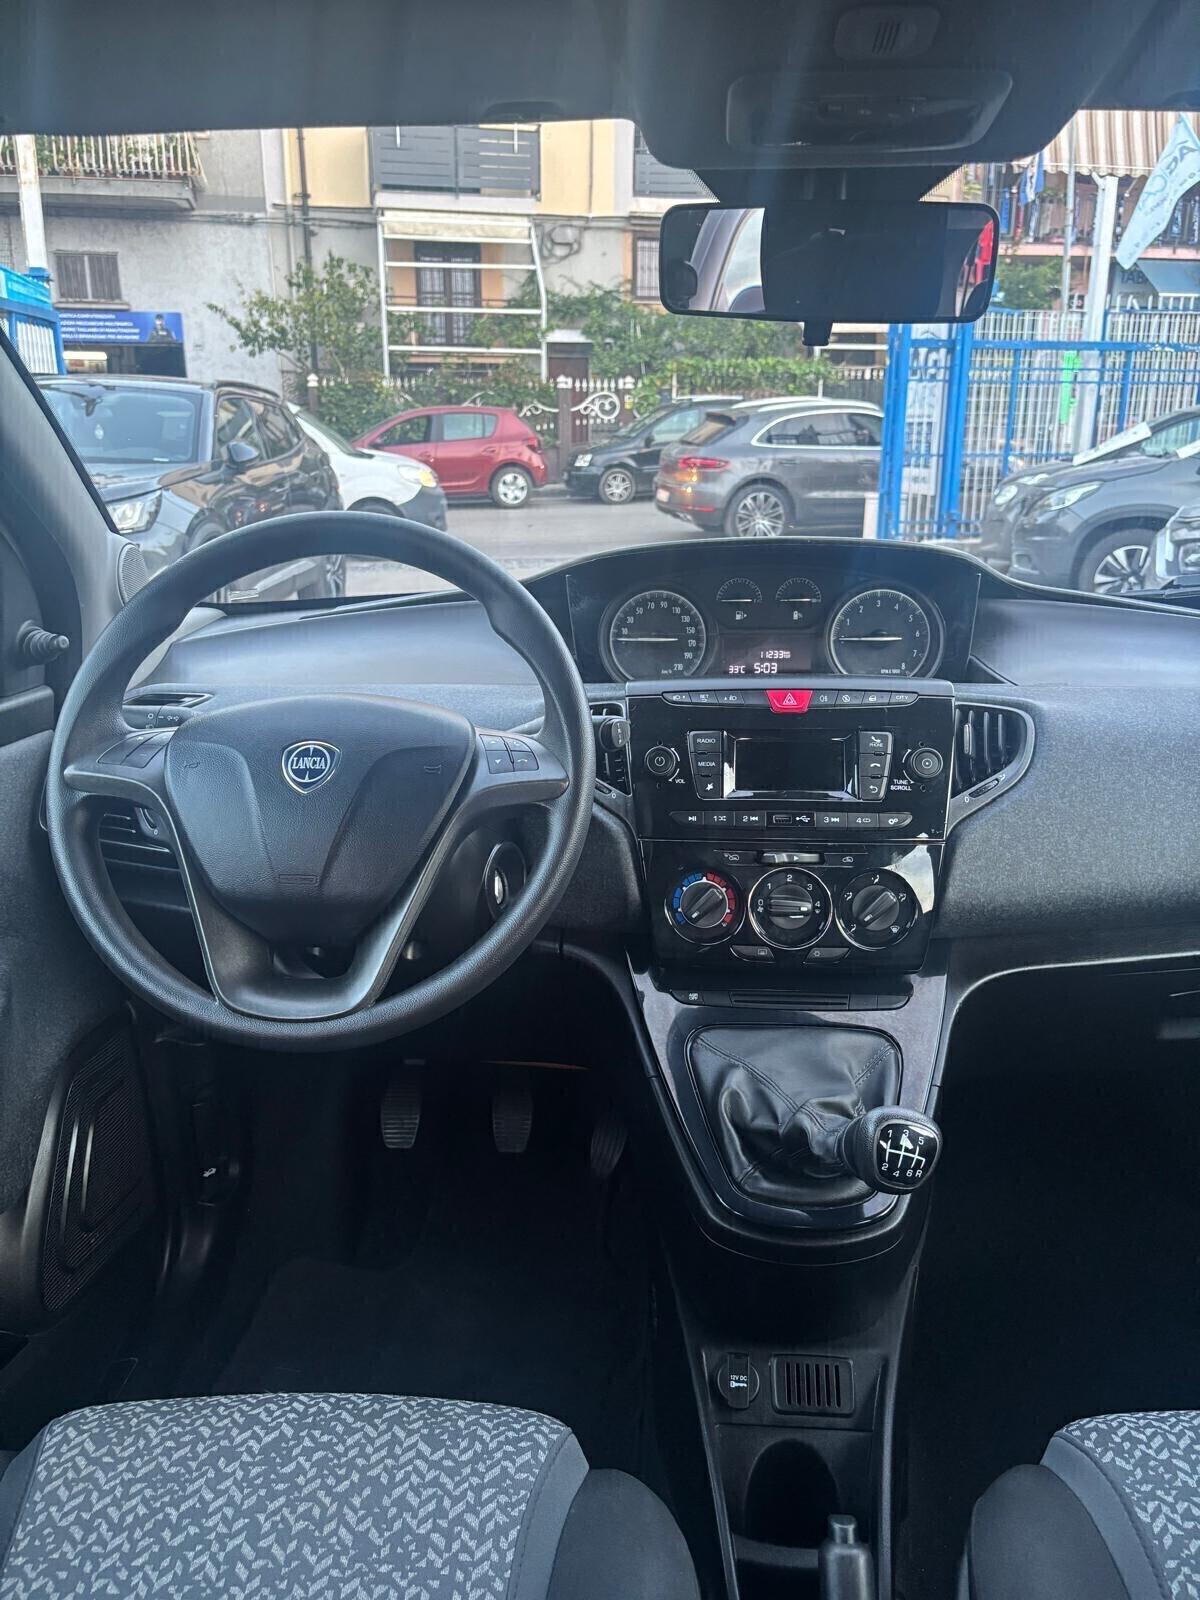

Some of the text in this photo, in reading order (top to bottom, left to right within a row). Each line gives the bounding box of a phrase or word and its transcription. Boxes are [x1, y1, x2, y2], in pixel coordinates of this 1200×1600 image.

[760, 650, 784, 658] 11233
[754, 663, 778, 674] 5:03
[292, 757, 325, 769] LANCIA
[918, 1137, 924, 1145] 5
